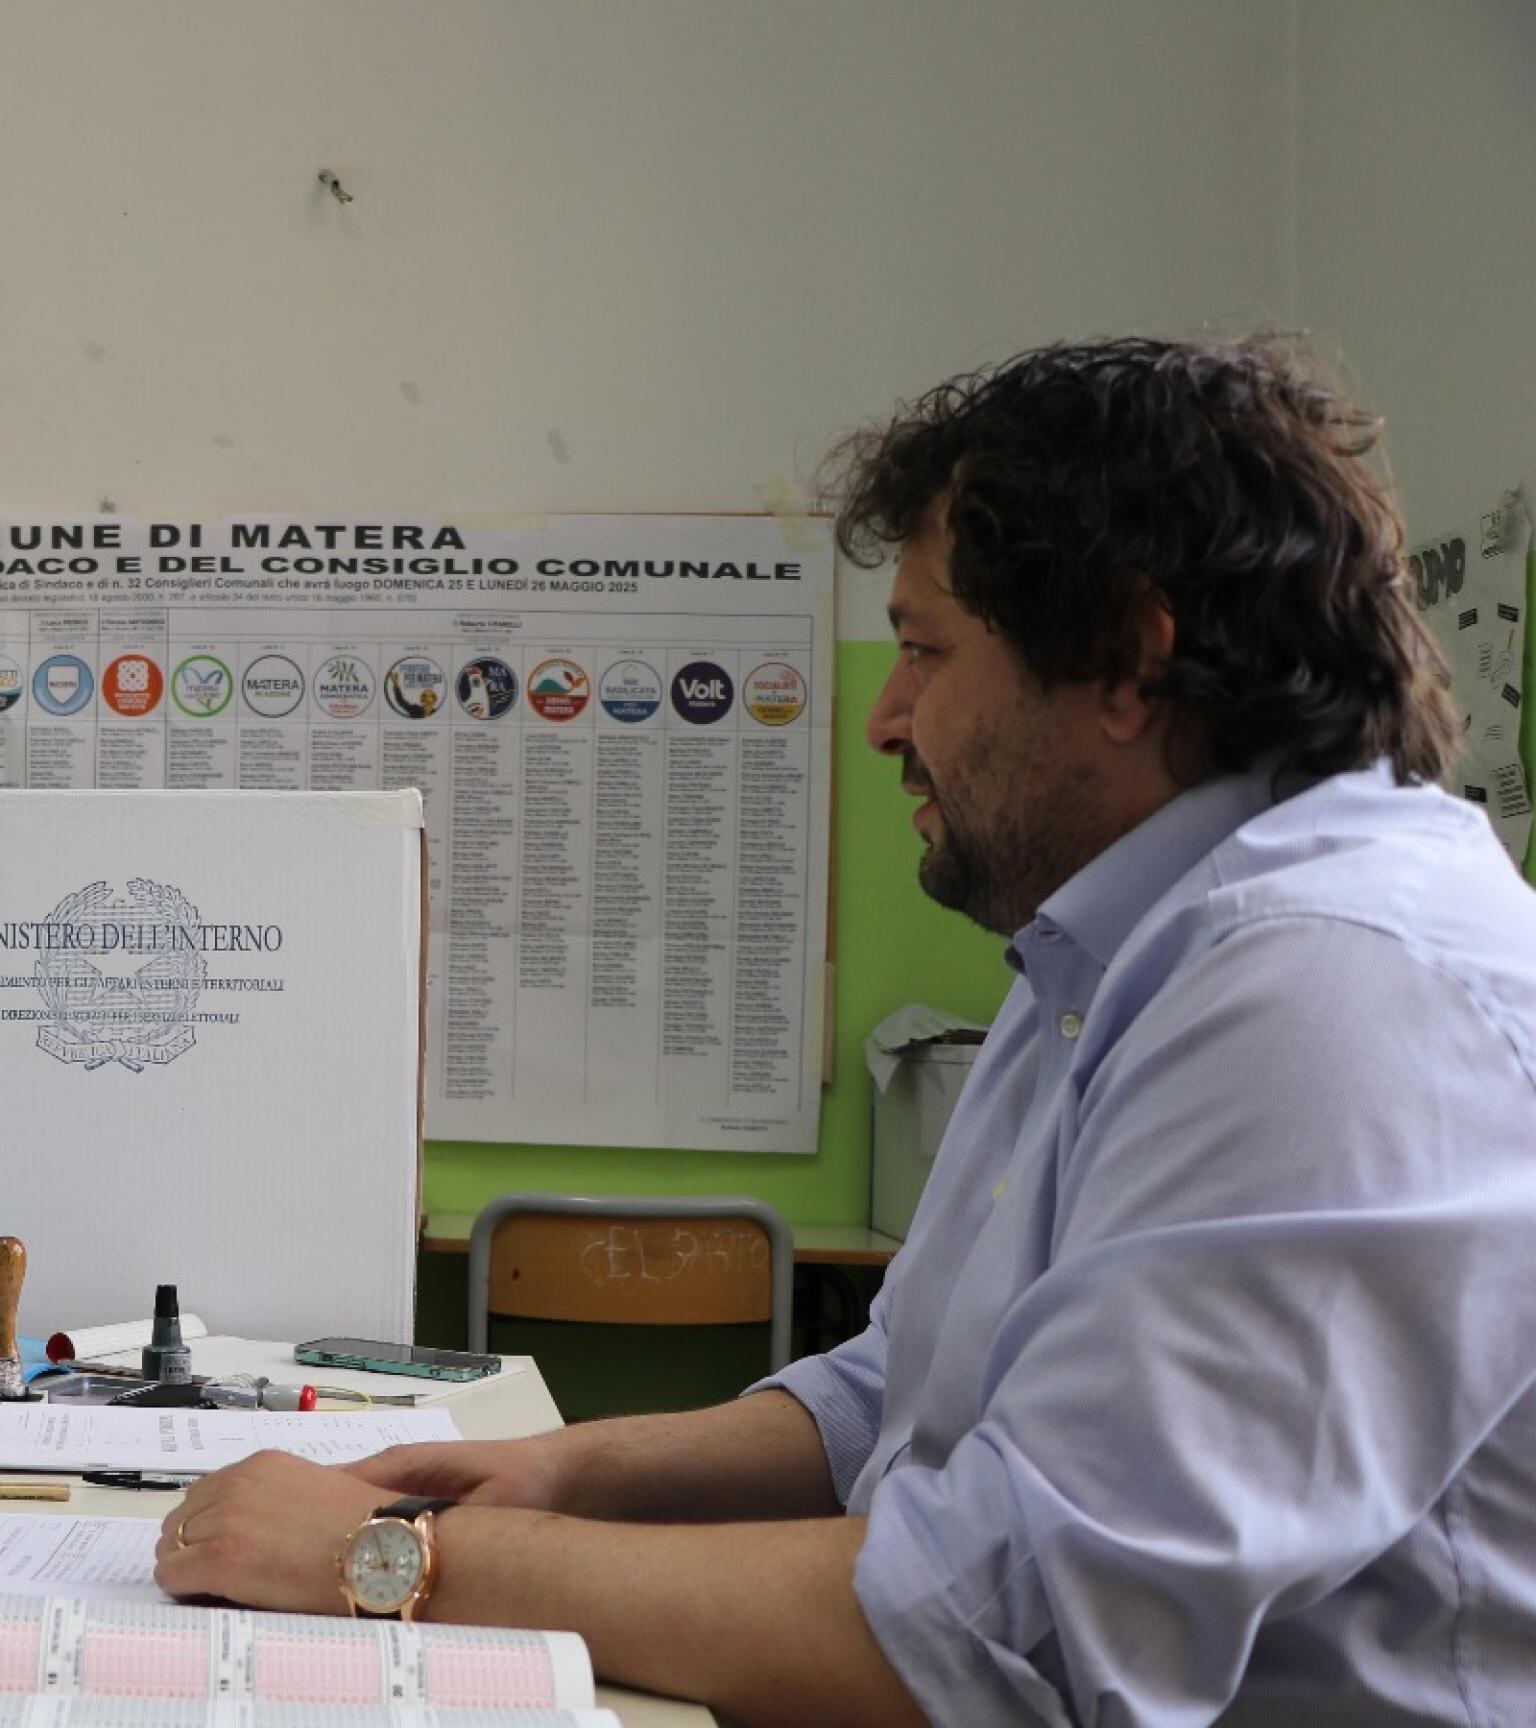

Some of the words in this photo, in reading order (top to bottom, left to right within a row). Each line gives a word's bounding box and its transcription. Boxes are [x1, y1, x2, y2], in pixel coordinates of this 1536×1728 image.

[149, 524, 202, 548] DI
[231, 524, 466, 550] MATERA
[116, 557, 143, 573] E
[159, 556, 245, 573] DEL
[261, 556, 519, 575] CONSIGLIO
[536, 558, 802, 580] COMUNALE
[19, 579, 30, 590] di
[34, 579, 83, 590] Sindaco
[86, 581, 94, 589] e
[97, 578, 109, 590] di
[127, 578, 142, 589] 32
[145, 578, 212, 592] Consiglieri
[215, 578, 273, 590] Comunali
[278, 578, 300, 590] che
[334, 578, 370, 592] luogo
[373, 579, 445, 591] DOMENICA
[448, 579, 463, 591] 25
[466, 580, 475, 590] E
[531, 580, 546, 592] 26
[550, 580, 605, 592] MAGGIO
[608, 581, 638, 592] 2025
[247, 679, 300, 690] MATERA
[320, 684, 369, 692] MATERA
[679, 679, 726, 700] Volt
[102, 923, 283, 952] DELL'INTERNO
[202, 978, 284, 992] TERRITORIALI
